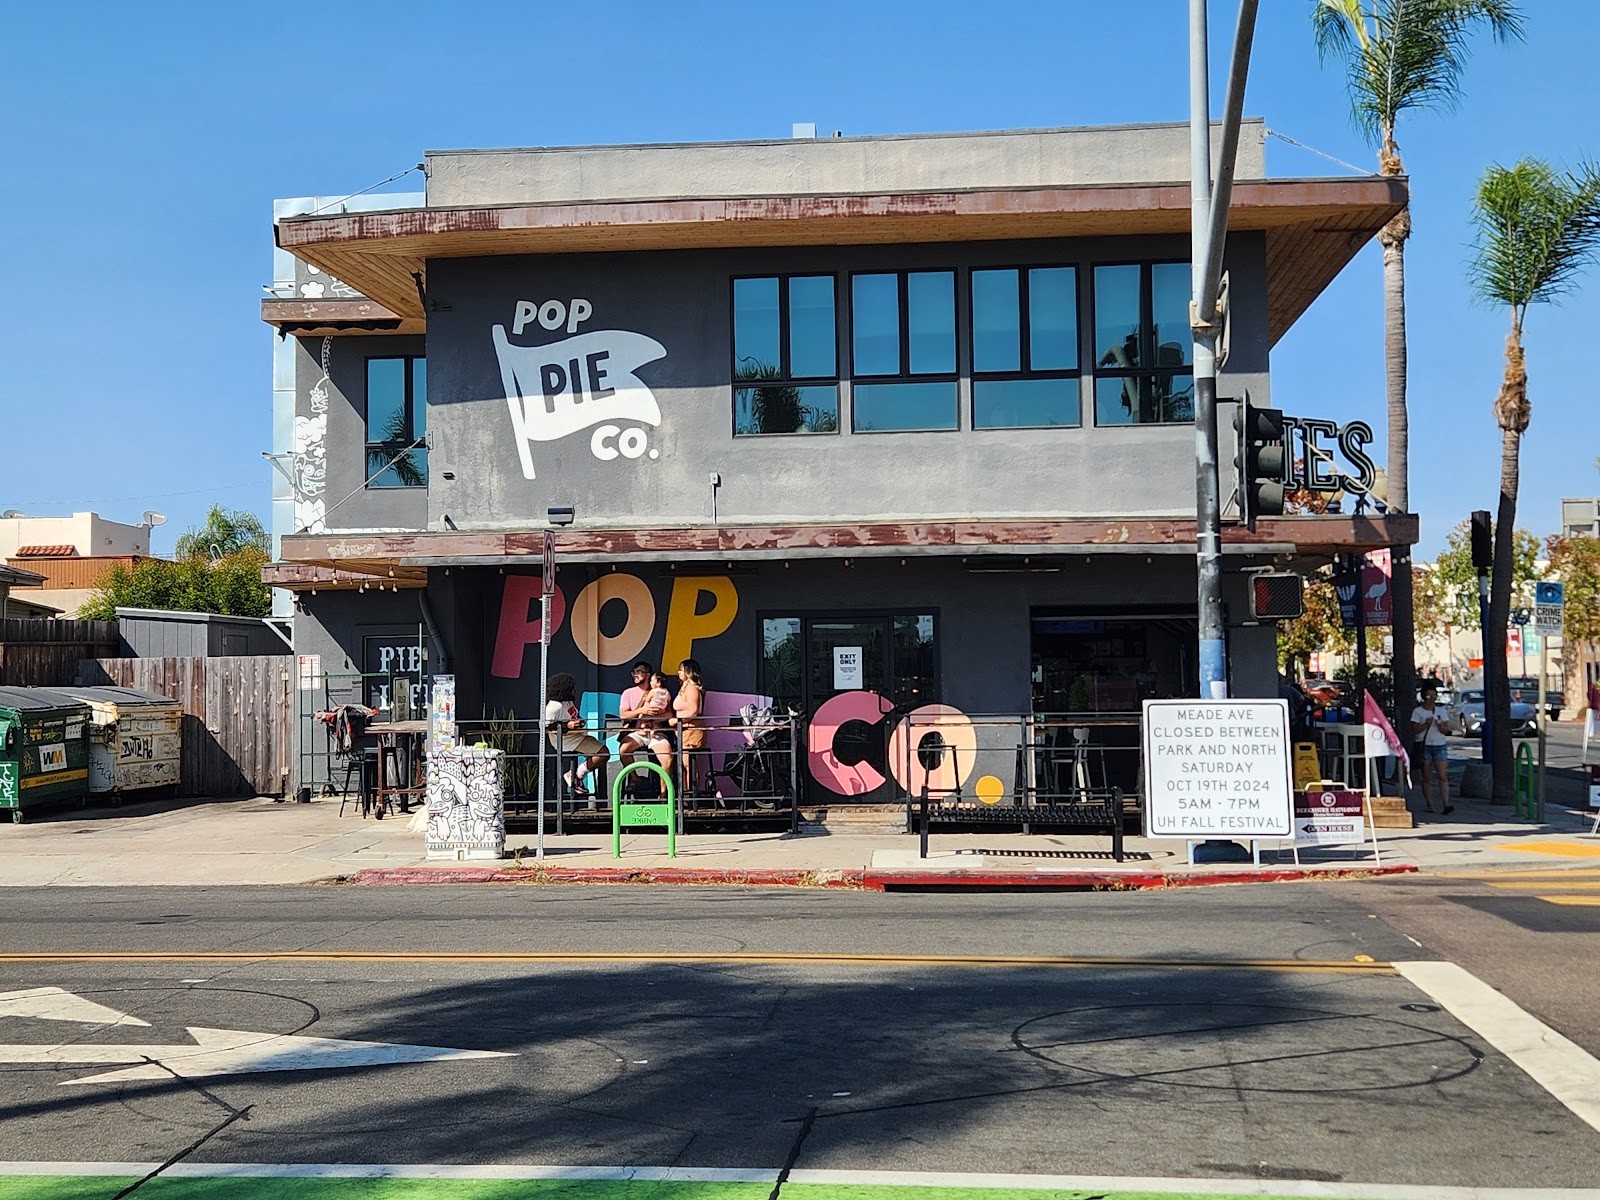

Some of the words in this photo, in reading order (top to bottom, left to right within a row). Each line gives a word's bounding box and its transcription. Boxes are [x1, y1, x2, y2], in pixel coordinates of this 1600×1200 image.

[512, 299, 593, 335] POP
[540, 350, 616, 414] PIE
[590, 424, 660, 461] CO.
[1281, 416, 1375, 495] IES
[1536, 607, 1562, 617] CRIME
[490, 572, 739, 679] POP
[1536, 616, 1562, 626] WATCH
[1177, 709, 1223, 720] MEADE
[1227, 709, 1254, 720] AVE
[1153, 727, 1214, 738] CLOSED
[1219, 726, 1280, 738] BETWEEN
[808, 690, 1005, 804] CO.
[1157, 744, 1194, 756] PARK
[1198, 744, 1226, 756] AND
[1231, 744, 1277, 756] NORTH
[42, 750, 64, 766] WM
[1181, 762, 1254, 773] SATURDAY
[1166, 780, 1192, 791] OCT
[1197, 780, 1228, 791] 19TH
[1233, 780, 1270, 791] 2024
[1178, 798, 1212, 809] 5AM
[1229, 798, 1261, 809] 7PM
[1157, 816, 1176, 828] UH
[1181, 816, 1216, 828] FALL
[1220, 816, 1284, 828] FESTIVAL
[1307, 824, 1327, 832] OPEN
